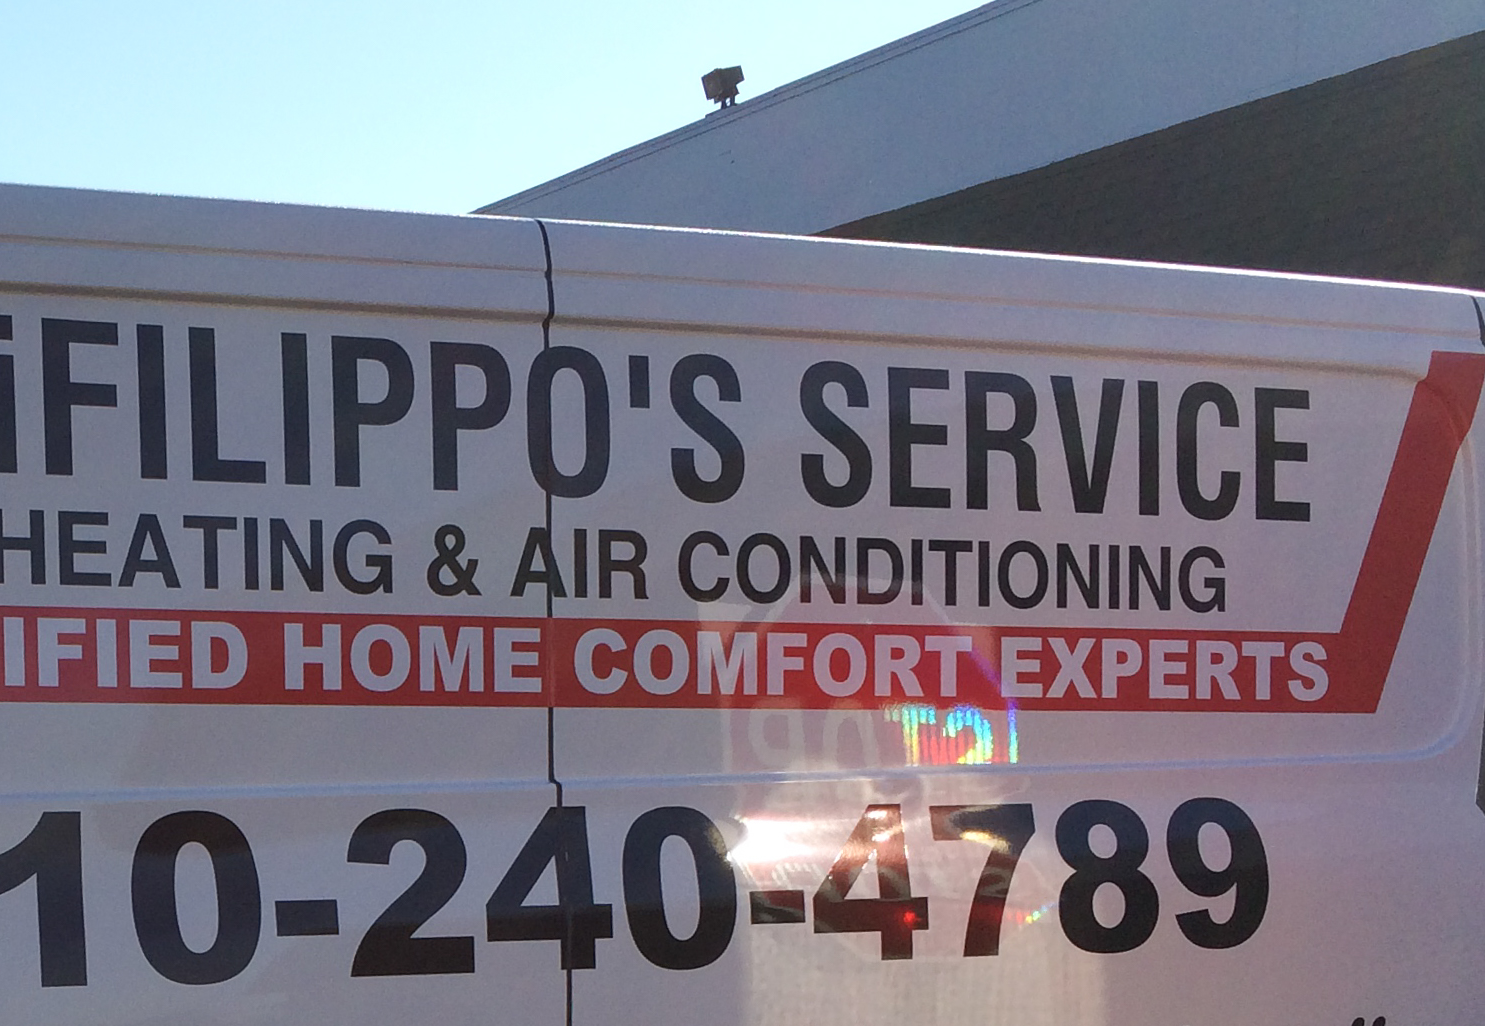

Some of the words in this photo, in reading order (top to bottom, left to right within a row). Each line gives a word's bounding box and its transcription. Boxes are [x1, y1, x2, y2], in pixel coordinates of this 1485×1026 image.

[799, 359, 1312, 523] SERVICE
[426, 523, 482, 598] &
[511, 526, 649, 600] AIR
[677, 530, 1228, 613] CONDITIONING
[283, 621, 543, 694] HOME
[573, 627, 974, 698] COMFORT
[1001, 636, 1331, 702] EXPERTS
